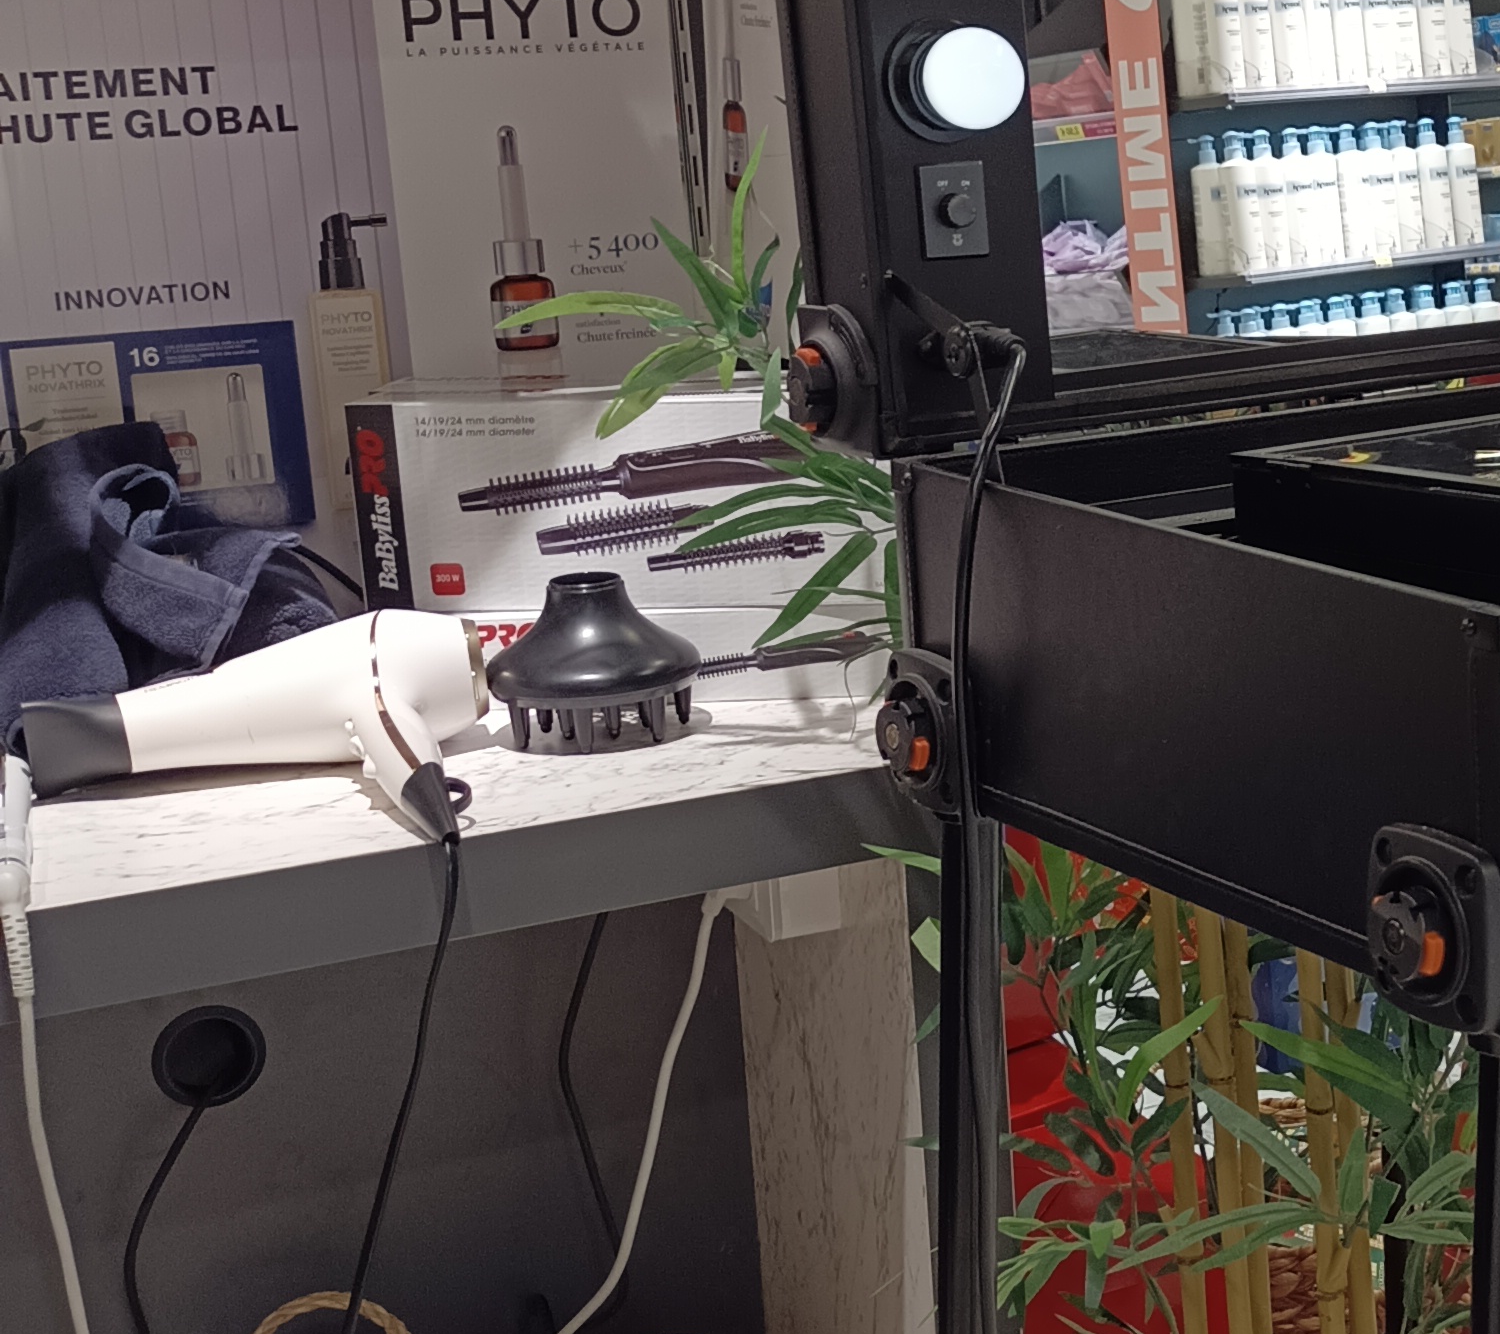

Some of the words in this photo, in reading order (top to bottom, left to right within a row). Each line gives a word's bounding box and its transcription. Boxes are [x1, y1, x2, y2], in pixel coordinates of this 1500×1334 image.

[406, 48, 428, 58] LA
[439, 44, 544, 57] PUISSANCE
[554, 40, 646, 53] VÉGÉTALE
[123, 103, 300, 140] GLOBAL
[608, 231, 660, 259] 400
[54, 279, 231, 312] INNOVATION
[320, 310, 373, 325] PHYTO
[321, 324, 373, 336] NOVATHRIX
[576, 330, 613, 344] Chute
[129, 345, 161, 368] 16
[25, 359, 104, 382] PHYTO
[27, 377, 106, 394] NOVATHRIX
[413, 416, 463, 428] 14/19/24
[465, 417, 486, 427] mm
[487, 415, 535, 427] diamètre
[414, 428, 464, 439] 14/19/24
[465, 428, 486, 438] mm
[487, 428, 536, 438] diameter
[435, 573, 450, 583] 300
[451, 573, 460, 582] W
[476, 623, 535, 649] PR
